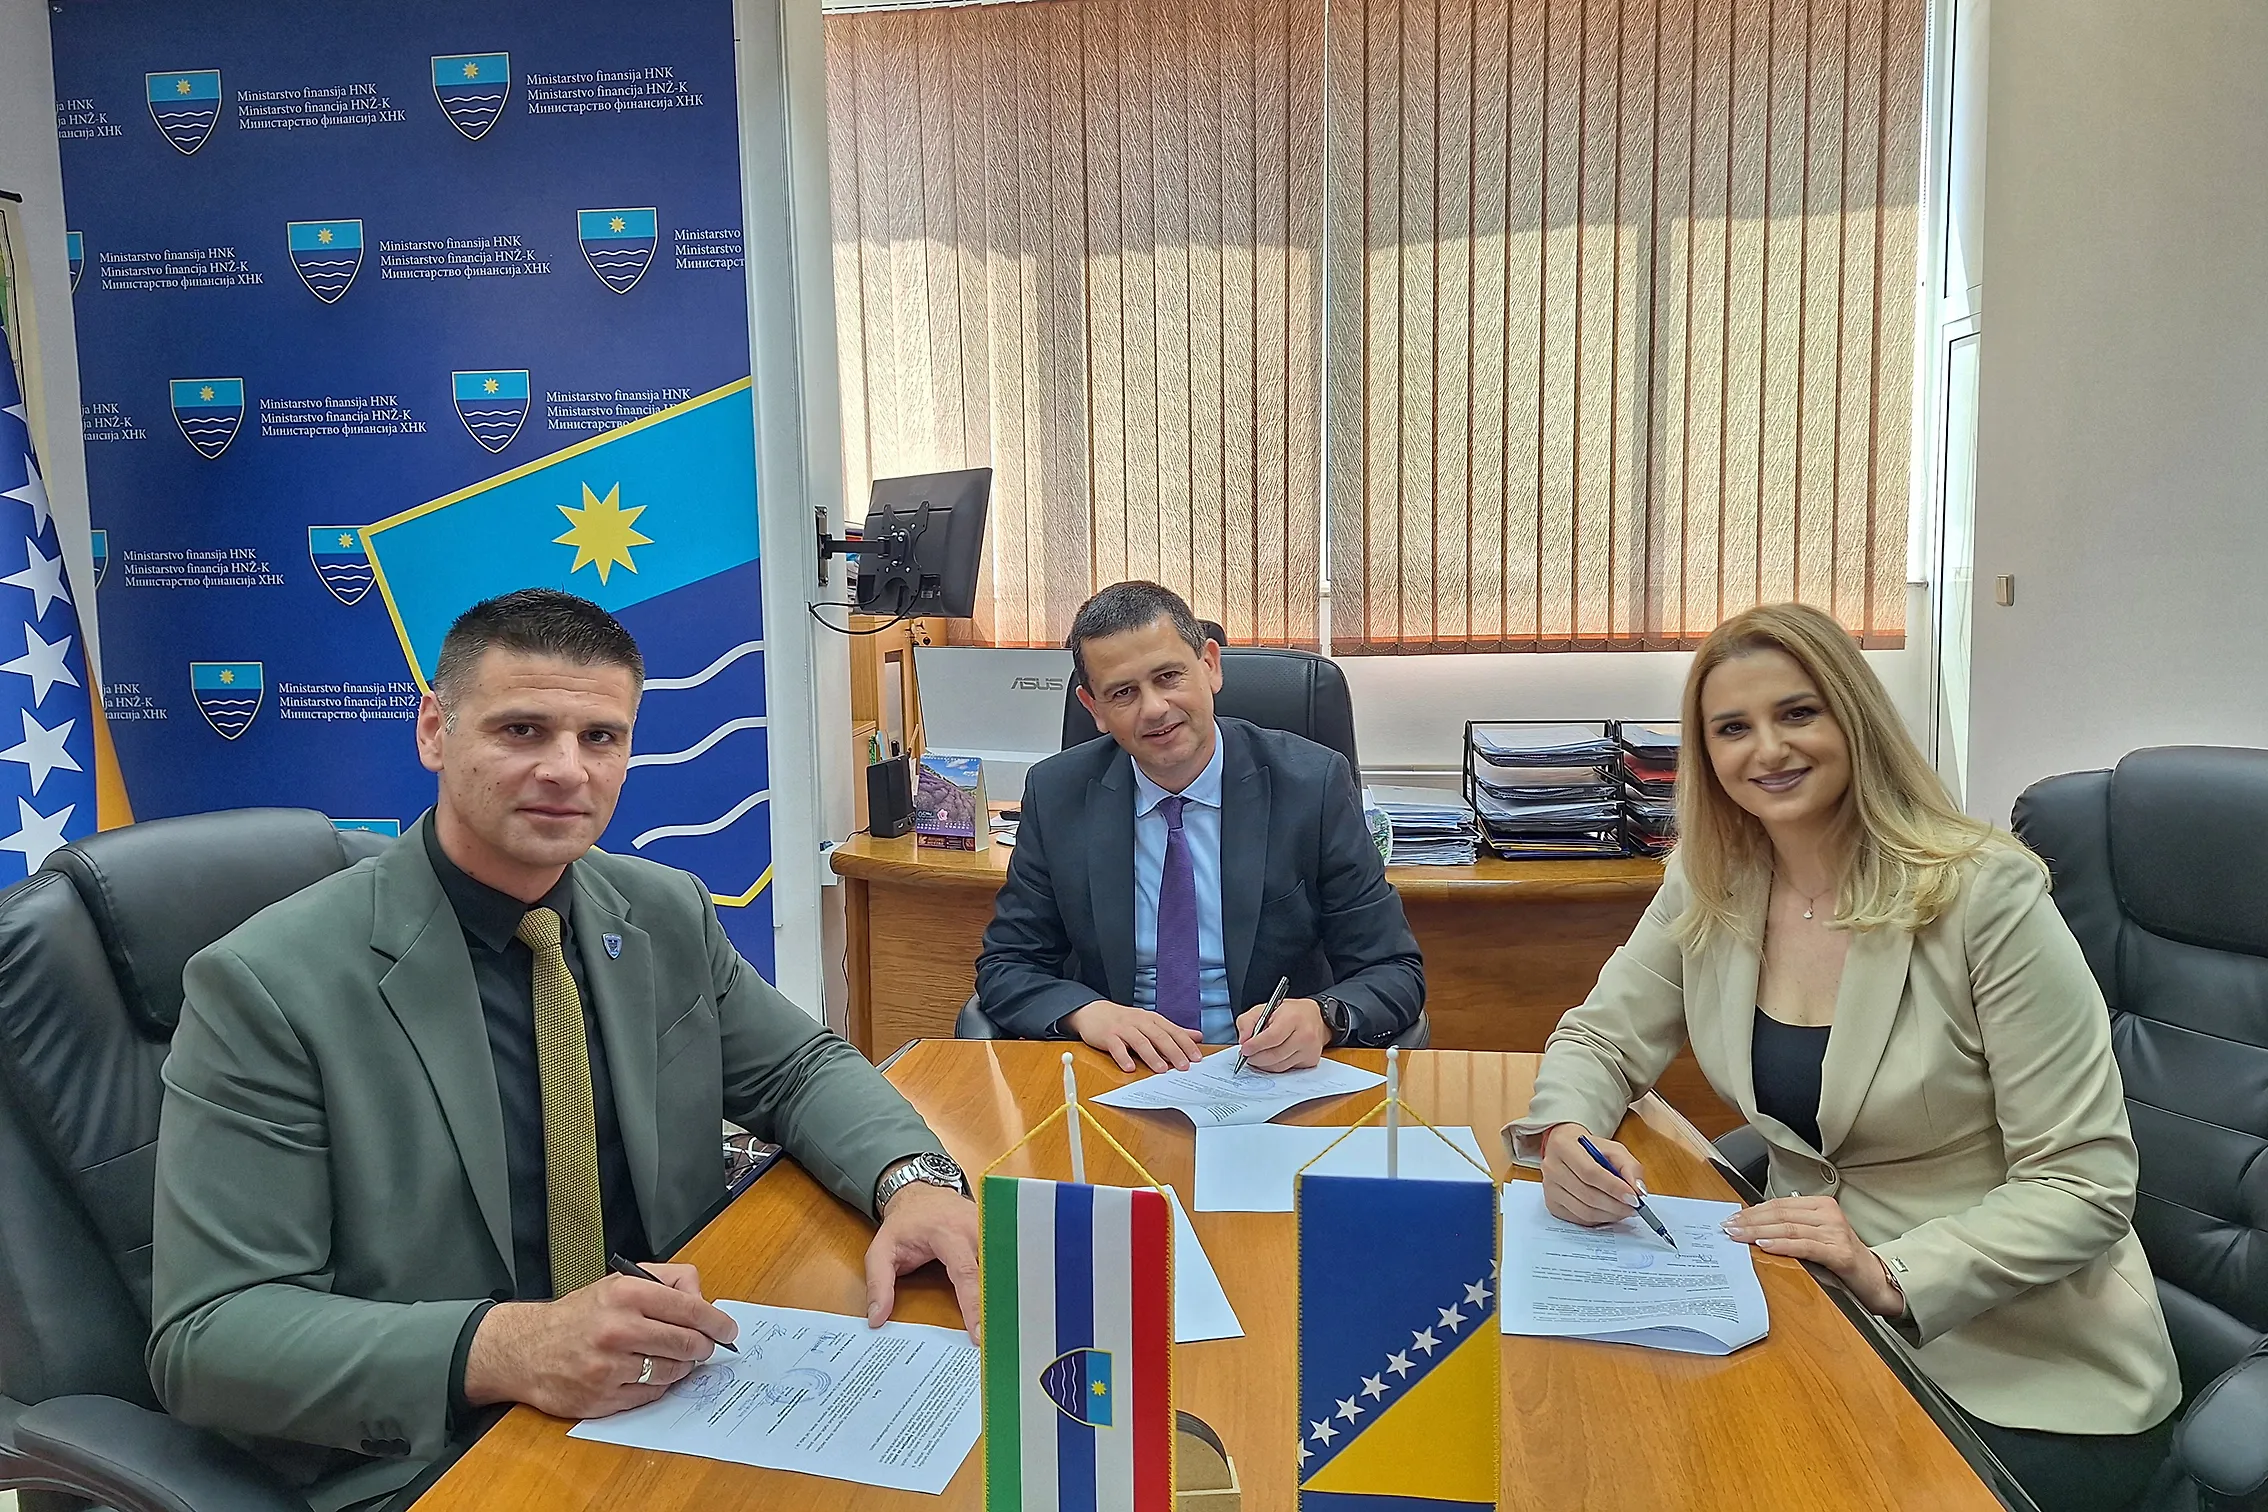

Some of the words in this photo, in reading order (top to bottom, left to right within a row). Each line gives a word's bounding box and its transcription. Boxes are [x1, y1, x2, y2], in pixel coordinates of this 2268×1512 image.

[527, 74, 593, 85] Ministarstvo
[597, 69, 641, 83] finansija
[645, 67, 673, 79] HNK
[238, 90, 301, 101] Ministarstvo
[304, 86, 346, 98] finansija
[349, 83, 377, 95] HNK
[528, 89, 594, 100] Ministarstvo
[597, 83, 643, 97] financija
[646, 80, 688, 94] HNŽ-K
[68, 99, 94, 110] HNK
[239, 105, 302, 116] Ministarstvo
[305, 99, 348, 113] financija
[351, 96, 390, 110] HNŽ-K
[529, 102, 611, 115] Министарство
[614, 98, 673, 113] финансија
[676, 94, 703, 106] ХНК
[69, 112, 107, 125] HNŽ-K
[240, 118, 318, 130] Министарство
[321, 114, 377, 128] финансија
[379, 110, 405, 122] ХНК
[97, 125, 122, 136] ХНК
[675, 229, 741, 240] Ministarstvo
[380, 241, 444, 251] Ministarstvo
[447, 237, 490, 250] finansija
[493, 236, 521, 247] HNK
[675, 244, 741, 255] Ministarstvo
[100, 252, 161, 263] Ministarstvo
[164, 249, 205, 261] finansija
[208, 247, 235, 258] HNK
[381, 255, 445, 266] Ministarstvo
[447, 251, 493, 264] financija
[494, 249, 535, 262] HNŽ-K
[101, 267, 162, 277] Ministarstvo
[165, 262, 207, 276] financija
[210, 260, 248, 273] HNŽ-K
[382, 268, 461, 280] Министарство
[464, 265, 521, 279] финансија
[524, 262, 551, 274] ХНК
[102, 279, 178, 291] Министарство
[181, 276, 235, 290] финансија
[238, 273, 263, 284] ХНК
[260, 399, 322, 409] Ministarstvo
[325, 397, 368, 409] finansija
[370, 395, 398, 406] HNK
[546, 391, 612, 402] Ministarstvo
[614, 389, 659, 403] finansija
[662, 389, 691, 400] HNK
[93, 403, 119, 414] HNK
[261, 413, 323, 423] Ministarstvo
[326, 409, 369, 423] financija
[372, 408, 412, 420] HNŽ-K
[547, 405, 613, 417] Ministarstvo
[615, 404, 660, 415] financija
[95, 416, 132, 428] HNŽ-K
[122, 429, 146, 439] ХНК
[262, 426, 340, 438] Министарство
[342, 423, 398, 437] финансија
[400, 422, 427, 433] ХНК
[124, 551, 184, 560] Ministarstvo
[186, 549, 227, 561] finansija
[230, 549, 256, 559] HNK
[125, 564, 185, 574] Ministarstvo
[187, 562, 229, 575] financija
[231, 561, 270, 573] HNŽ-K
[126, 577, 200, 589] Министарство
[202, 576, 256, 588] финансија
[258, 574, 284, 585] ХНК
[114, 684, 140, 694] HNK
[278, 683, 341, 694] Ministarstvo
[343, 682, 385, 695] finansija
[388, 683, 415, 693] HNK
[1010, 676, 1064, 691] ASUS
[116, 696, 153, 707] HNŽ-K
[280, 697, 342, 707] Ministarstvo
[344, 696, 387, 709] financija
[390, 695, 422, 707] HNŽ-
[143, 709, 167, 719] ХНК
[280, 709, 357, 722] Министарство
[359, 708, 415, 722] финансија
